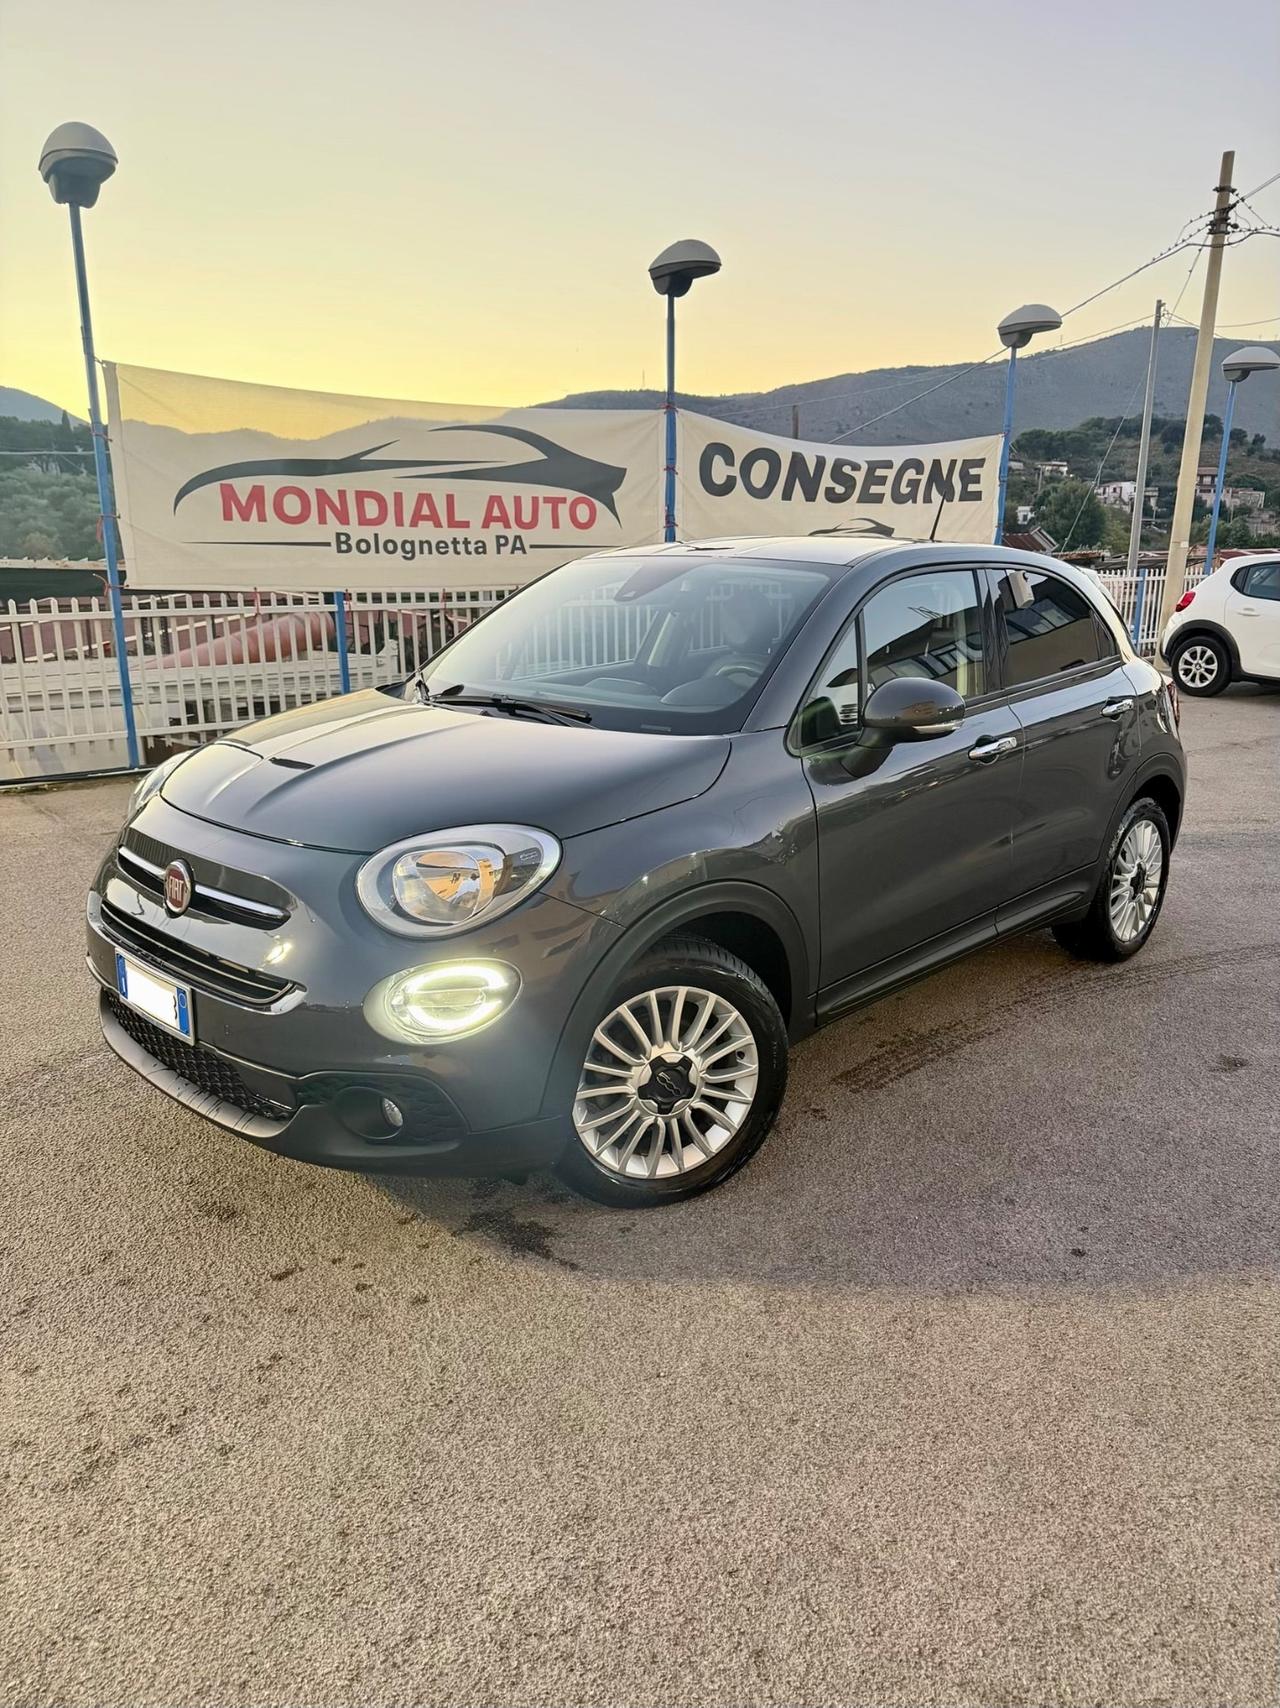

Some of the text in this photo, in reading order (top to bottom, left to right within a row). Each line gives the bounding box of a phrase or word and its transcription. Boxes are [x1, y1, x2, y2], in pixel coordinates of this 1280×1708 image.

[699, 442, 986, 504] CONSEGNE
[219, 483, 597, 531] MONDIAL AUTO
[335, 531, 527, 561] Bolognetta PA
[168, 875, 184, 901] FIAT
